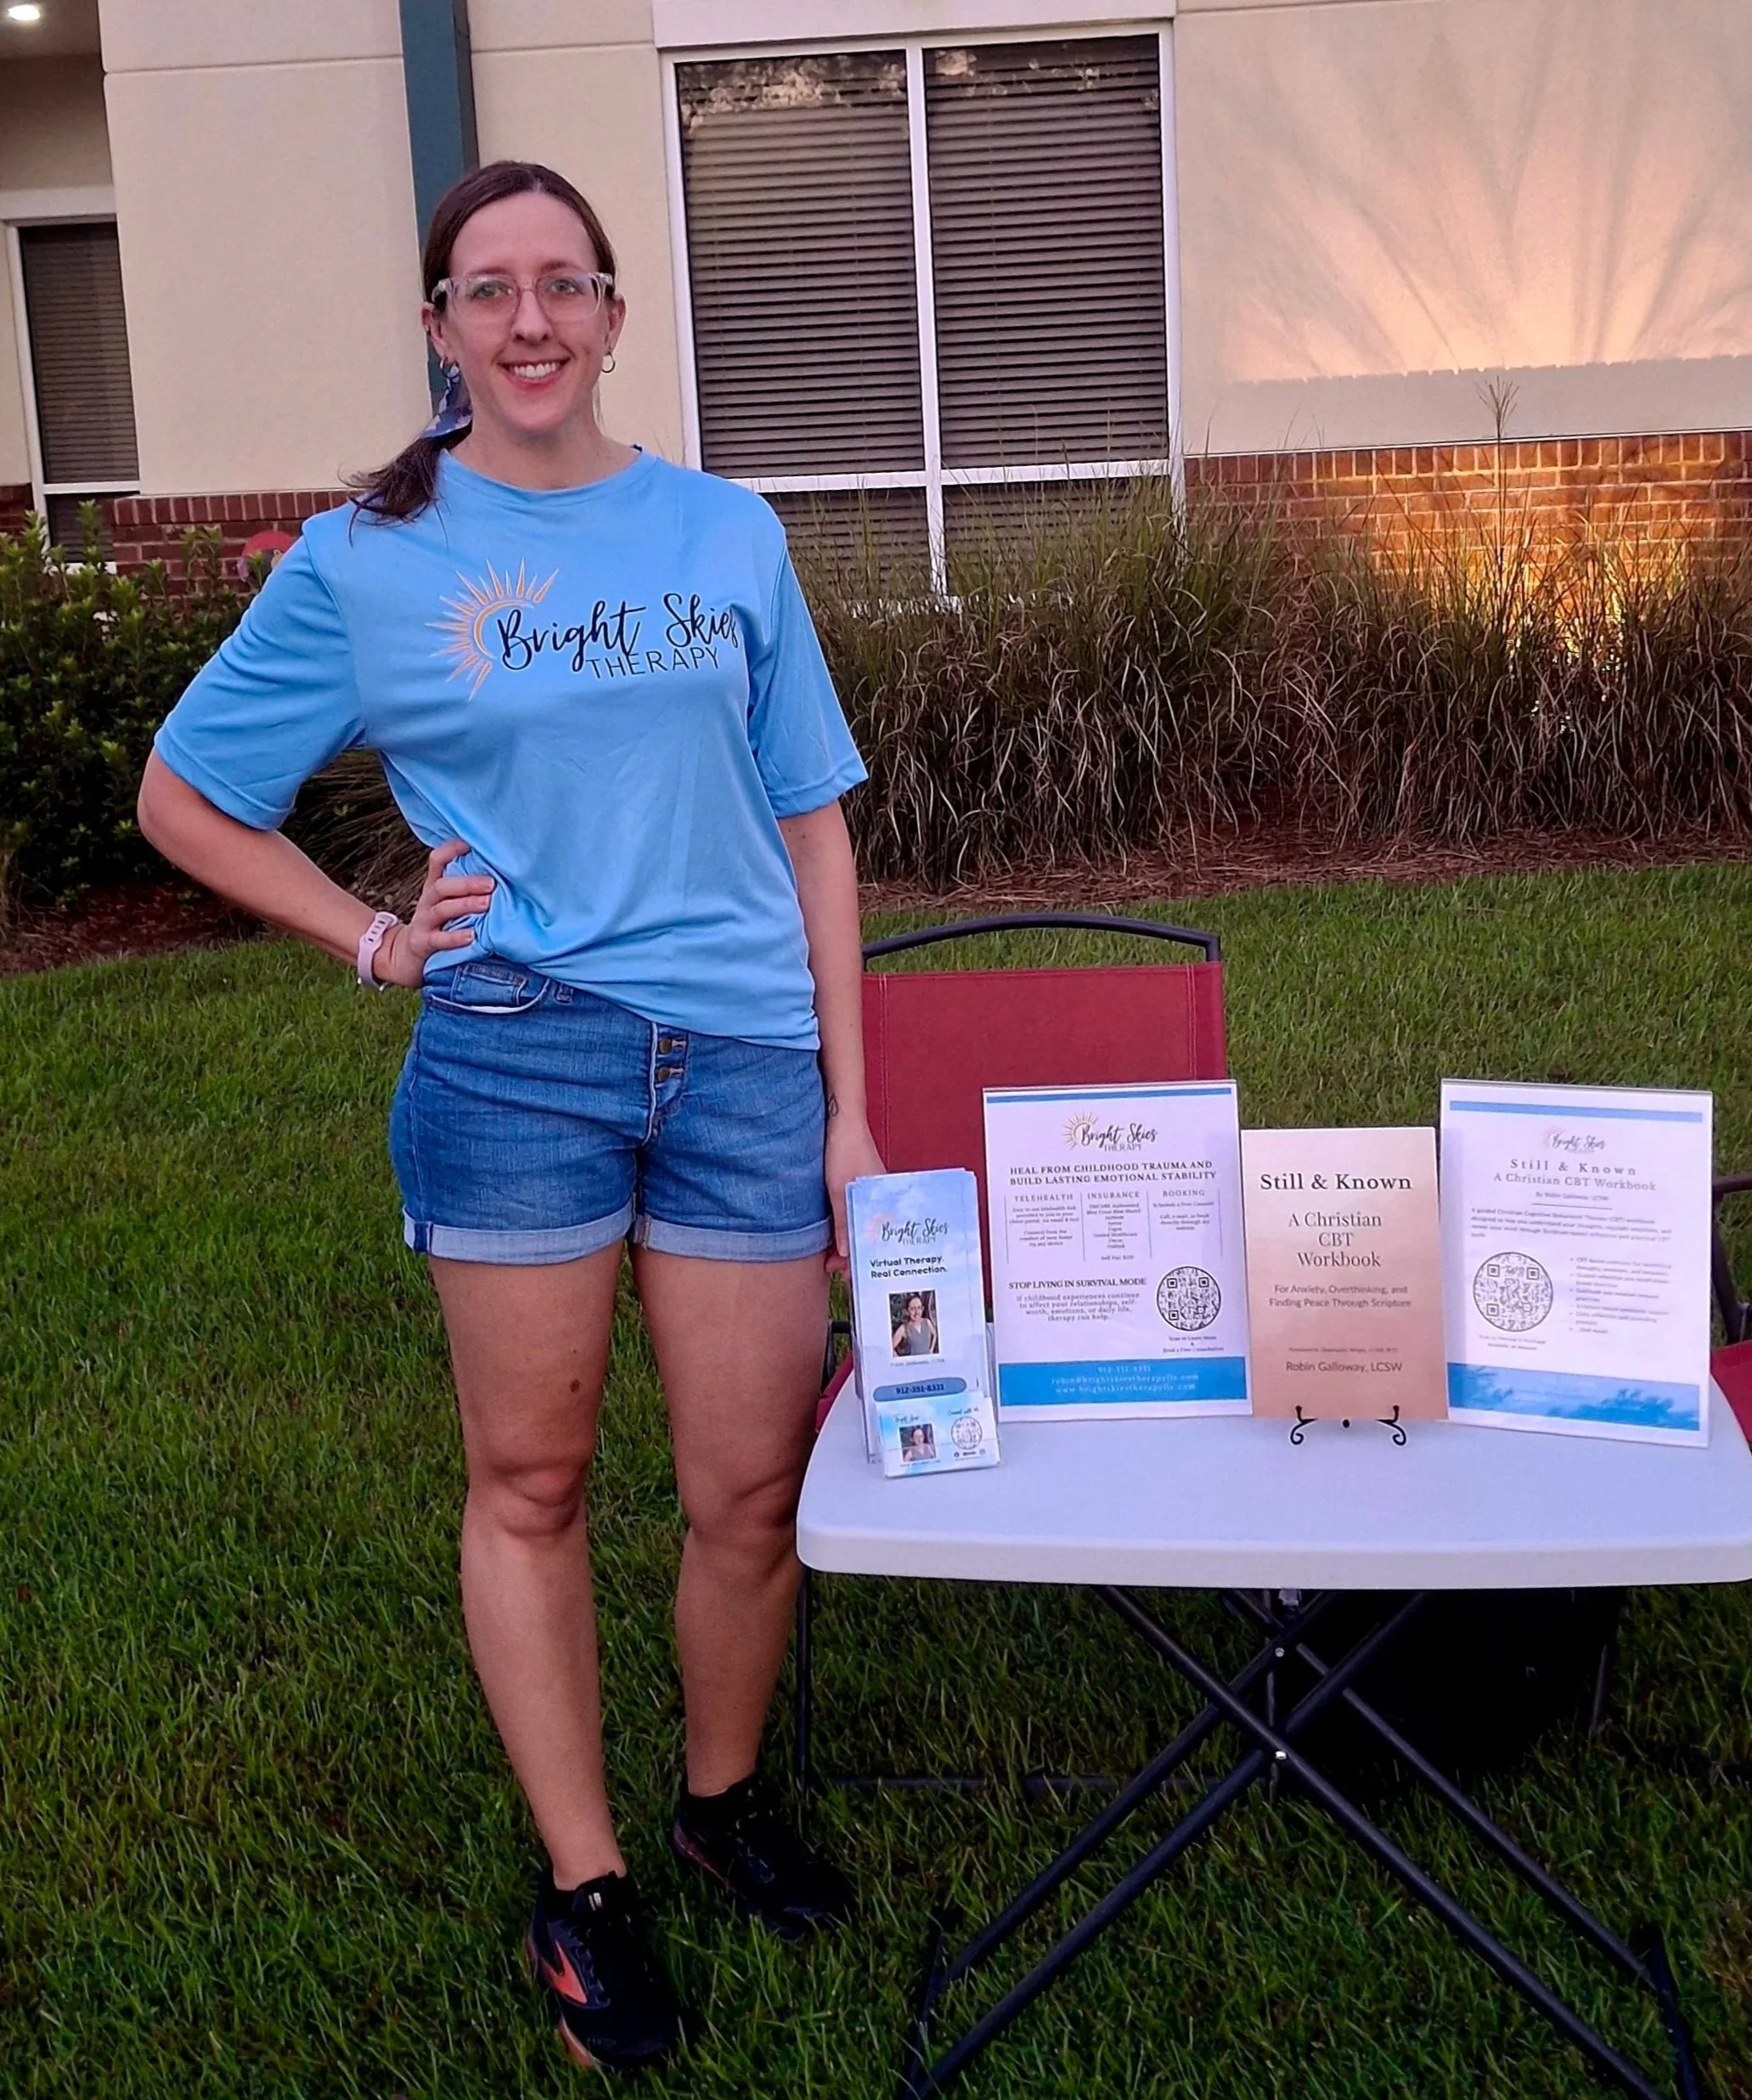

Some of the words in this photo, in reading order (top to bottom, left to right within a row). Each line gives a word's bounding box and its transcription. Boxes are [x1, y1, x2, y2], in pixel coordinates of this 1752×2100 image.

[498, 600, 646, 673] Bright
[662, 592, 740, 649] Skies
[586, 646, 719, 679] THERAPY
[1081, 1124, 1124, 1148] Bright
[1126, 1123, 1158, 1143] Skies
[1010, 1167, 1038, 1175] HEAL
[1073, 1163, 1139, 1173] CHILDHOOD
[1141, 1162, 1186, 1171] TRAUMA
[1190, 1160, 1213, 1168] AND
[1510, 1158, 1549, 1171] Still
[1558, 1161, 1569, 1172] &
[1579, 1163, 1637, 1176] Known
[1010, 1177, 1043, 1185] BUILD
[1045, 1175, 1091, 1185] LASTING
[1094, 1173, 1159, 1183] EMOTIONAL
[1161, 1171, 1217, 1180] STABILITY
[1259, 1172, 1304, 1190] Still
[1310, 1174, 1328, 1190] &
[1334, 1173, 1412, 1190] Known
[1493, 1173, 1502, 1182] A
[1505, 1173, 1560, 1185] Christian
[1564, 1177, 1591, 1187] CBT
[1594, 1178, 1656, 1191] Workbook
[1014, 1193, 1073, 1202] TELEHEALTH
[1087, 1191, 1140, 1200] INSURANCE
[1163, 1189, 1206, 1197] BOOKING
[1287, 1213, 1300, 1227] A
[1304, 1211, 1382, 1227] Christian
[882, 1220, 921, 1243] Bright
[922, 1217, 949, 1237] Skies
[1318, 1231, 1354, 1247] CBT
[869, 1258, 902, 1268] Virtual
[1297, 1251, 1382, 1267] Workbook
[870, 1270, 892, 1279] Real
[893, 1265, 948, 1277] Connection.
[1033, 1281, 1062, 1289] LIVING
[1076, 1278, 1118, 1287] SURVIVAL
[1119, 1277, 1147, 1286] MODE
[1274, 1285, 1289, 1293] For
[1290, 1285, 1327, 1295] Anxiety,
[1327, 1285, 1389, 1295] Overthinking,
[1269, 1298, 1302, 1309] Finding
[1304, 1298, 1329, 1307] Peace
[1332, 1298, 1369, 1309] Through
[1371, 1298, 1411, 1309] Scripture
[1286, 1361, 1315, 1371] Robin
[1371, 1361, 1403, 1372] LCSW
